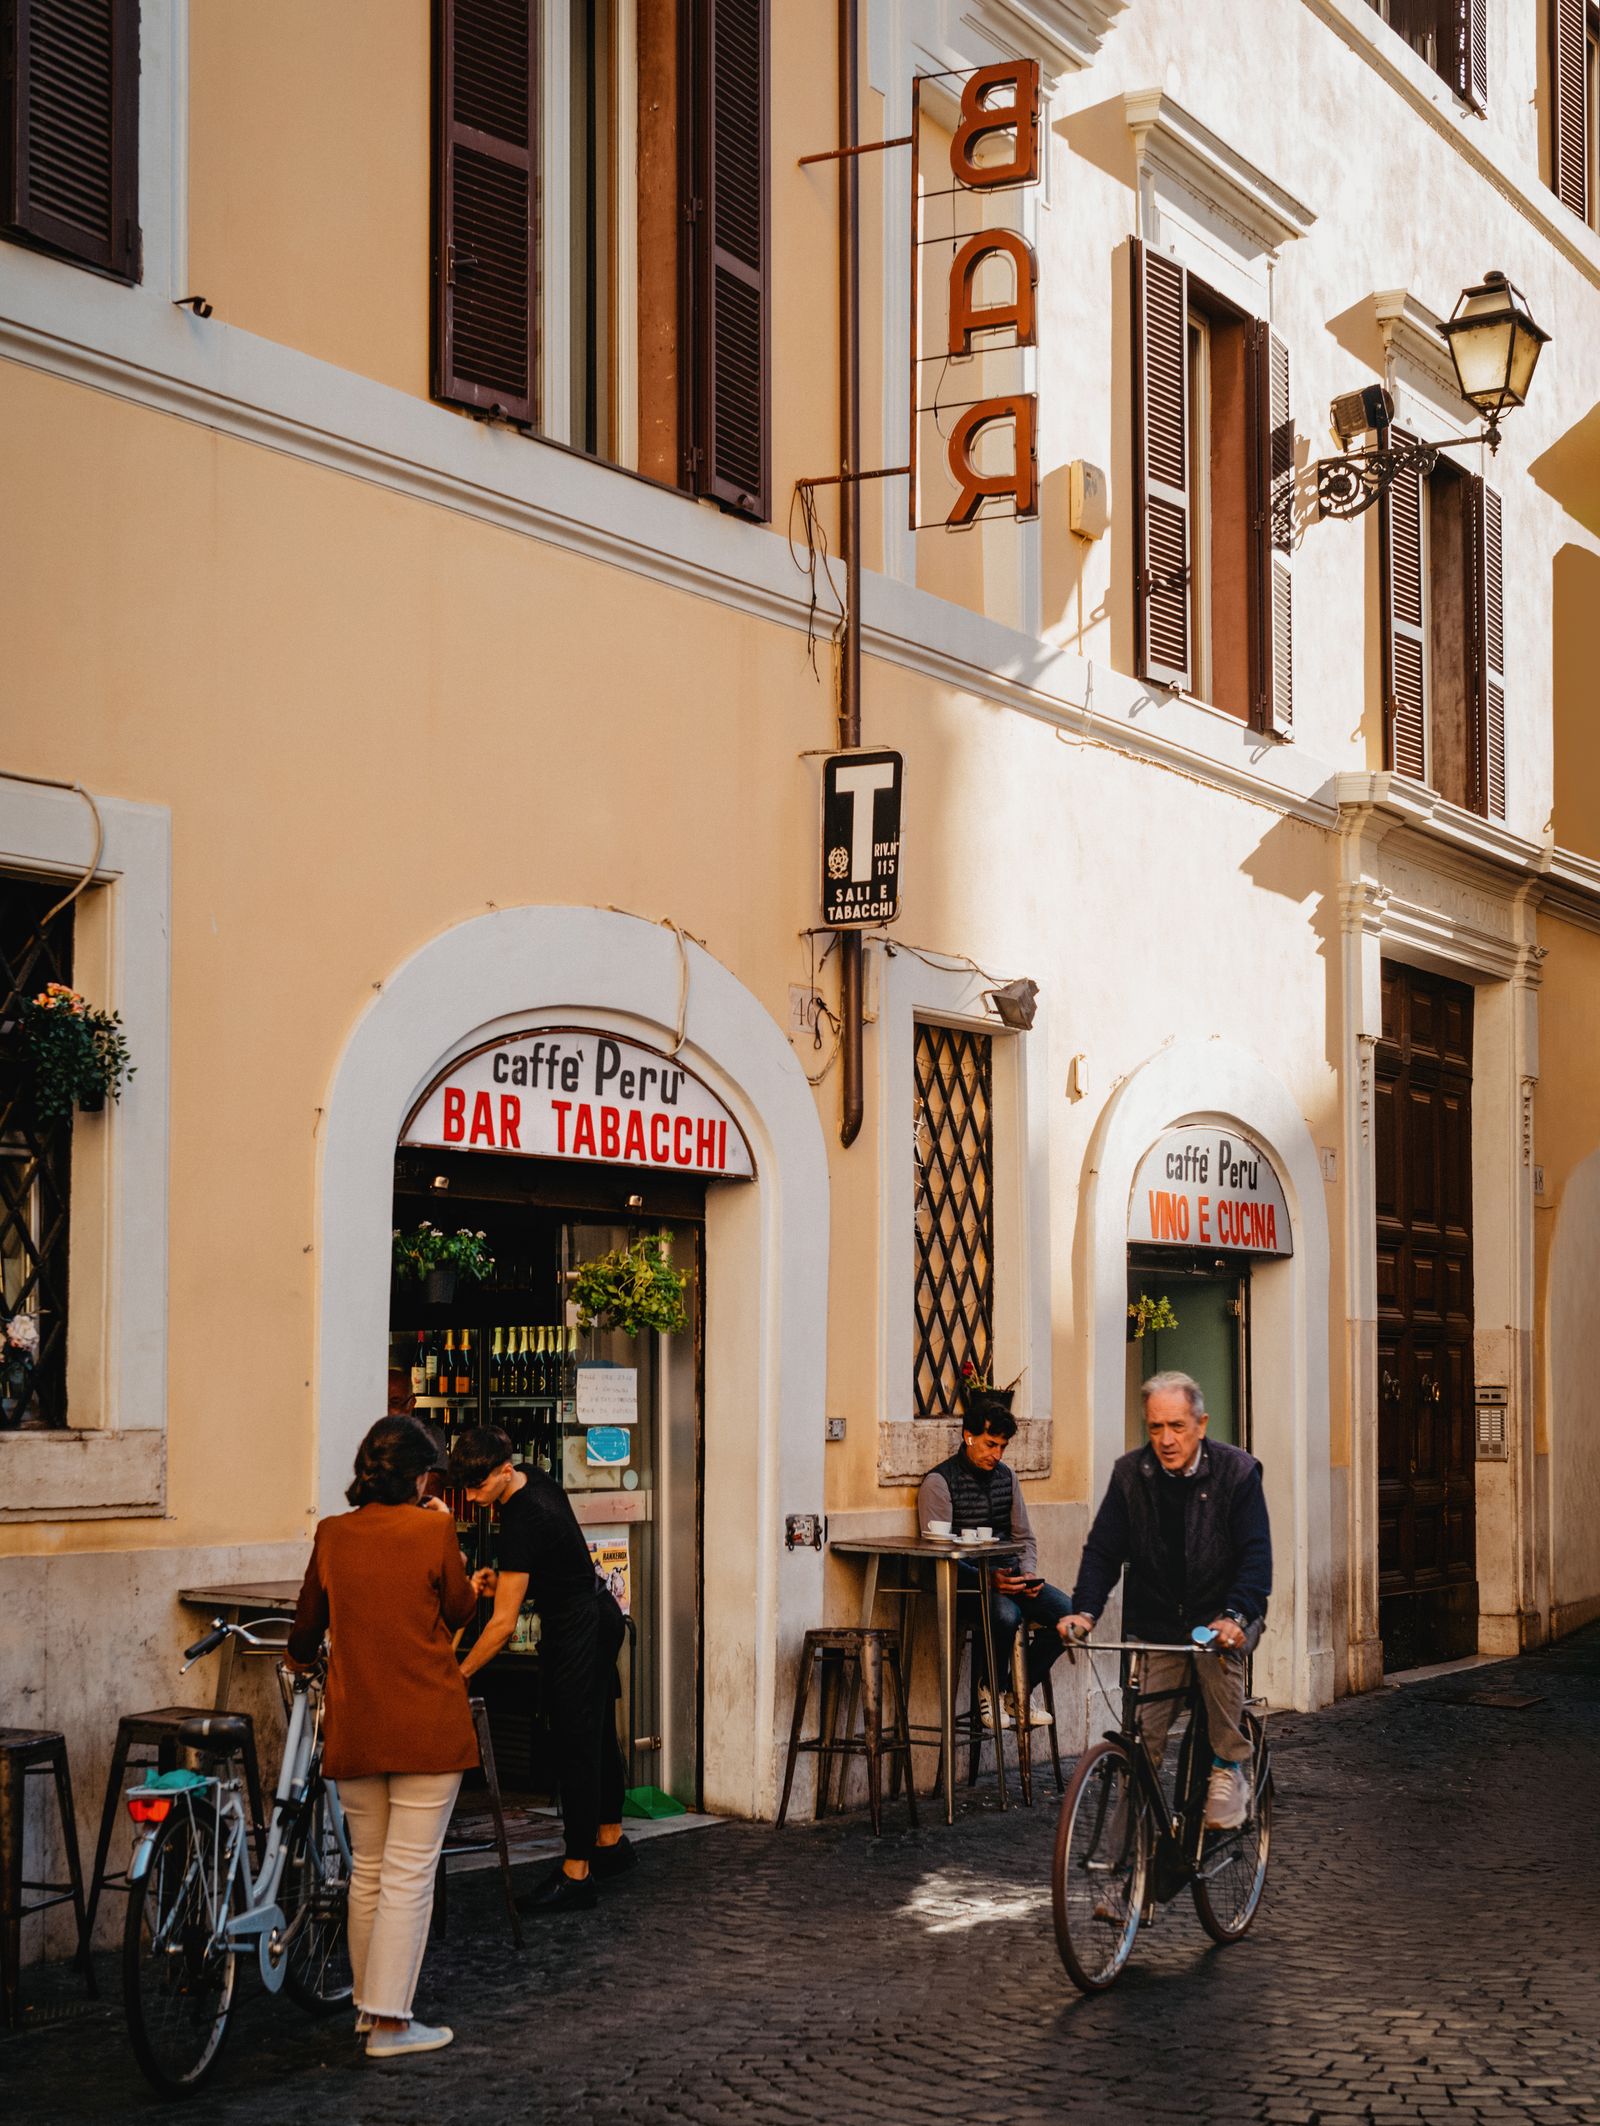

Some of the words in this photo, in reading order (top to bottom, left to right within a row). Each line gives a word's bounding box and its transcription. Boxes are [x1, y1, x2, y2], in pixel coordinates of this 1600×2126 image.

[835, 761, 895, 883] T
[877, 860, 895, 876] 115
[827, 901, 894, 921] TABACCHI
[835, 887, 870, 903] SALI
[880, 884, 888, 899] E
[443, 1086, 521, 1149] BAR
[551, 1100, 728, 1169] TABACCHI
[1148, 1190, 1190, 1242] VINO
[1198, 1196, 1211, 1244] E
[1217, 1199, 1278, 1250] CUCINA
